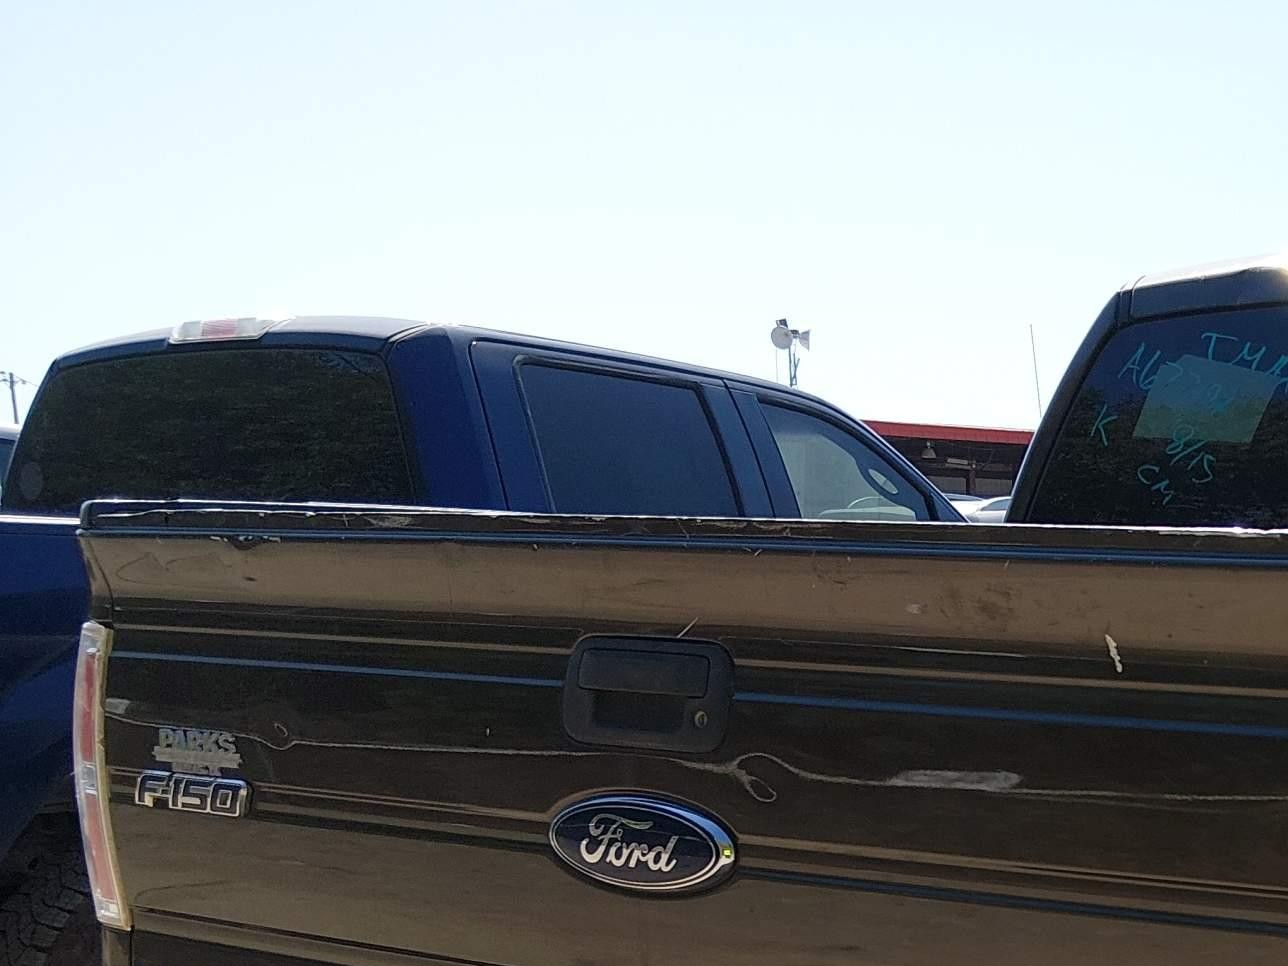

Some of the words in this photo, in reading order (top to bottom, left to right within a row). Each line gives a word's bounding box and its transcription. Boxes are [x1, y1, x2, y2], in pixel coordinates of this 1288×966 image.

[1090, 404, 1118, 447] K
[1166, 423, 1217, 484] 8/15
[157, 727, 238, 754] PARKS
[580, 813, 679, 873] Ford
